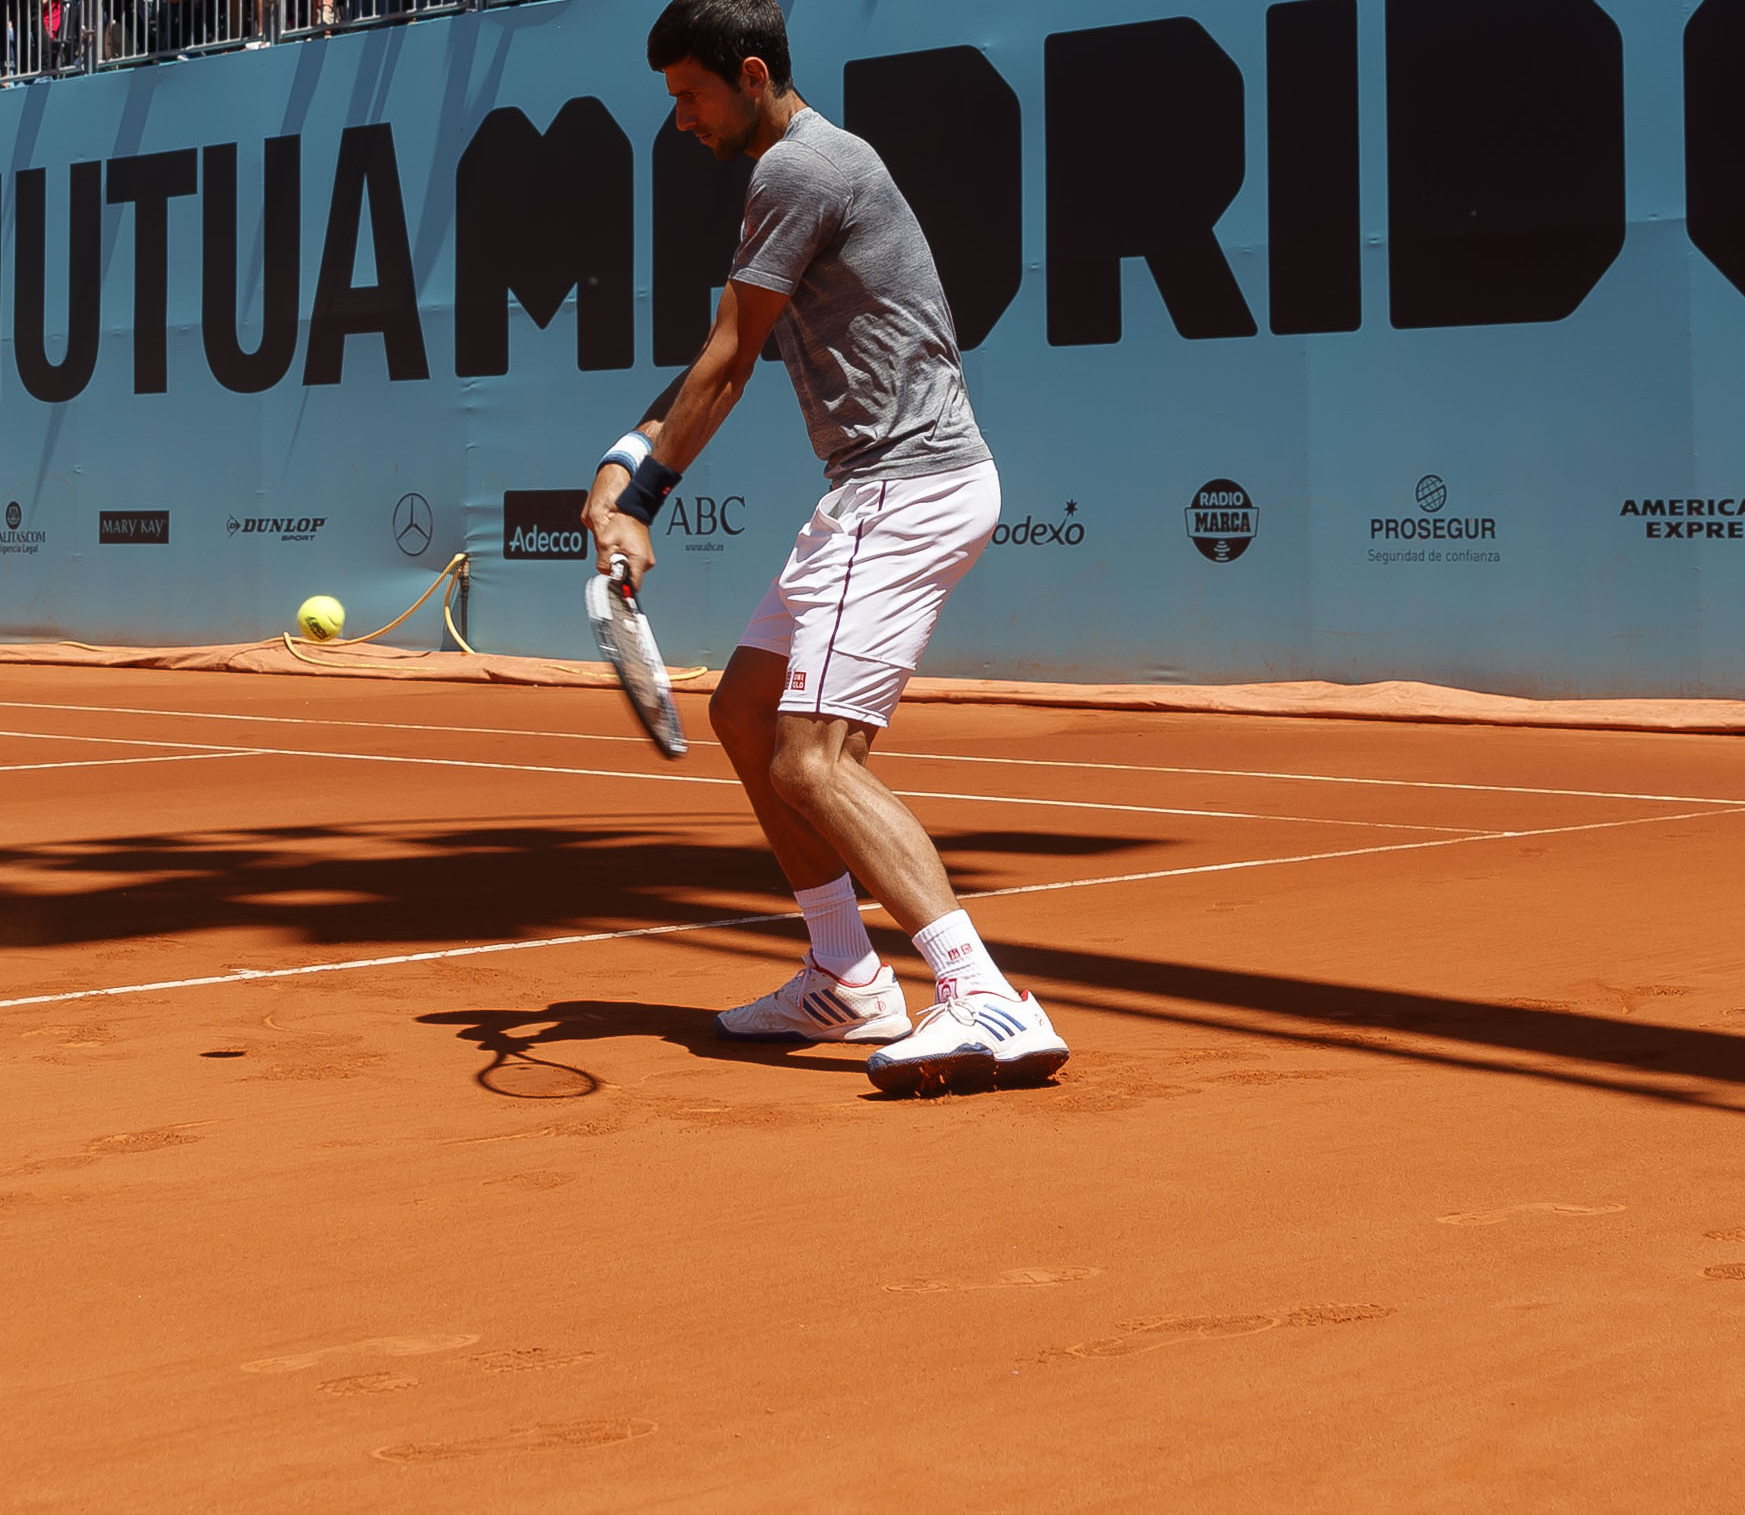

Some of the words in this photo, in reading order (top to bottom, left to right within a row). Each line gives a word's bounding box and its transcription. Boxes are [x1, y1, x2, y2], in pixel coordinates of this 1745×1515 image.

[1199, 491, 1245, 507] RADIO
[242, 517, 326, 533] DUNLOP
[665, 495, 746, 536] ABC
[1194, 511, 1251, 533] MARCA
[102, 519, 137, 537] MARY
[140, 518, 163, 536] KAY
[509, 524, 582, 553] Adecco
[992, 511, 1085, 546] odexo
[1370, 517, 1496, 540] PROSEGUR
[1367, 548, 1425, 565] Seguridad
[1428, 549, 1442, 562] de
[1445, 549, 1501, 563] confianza
